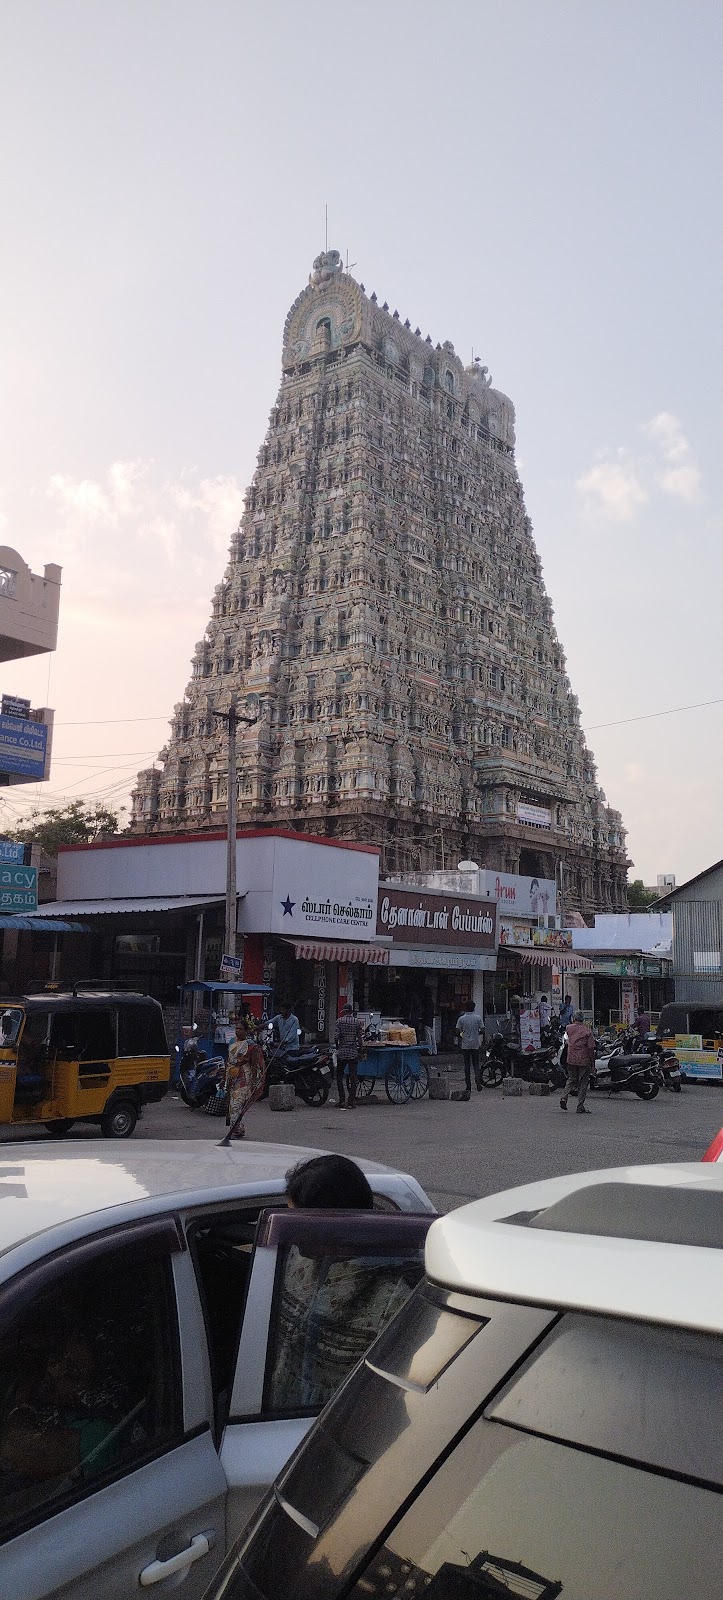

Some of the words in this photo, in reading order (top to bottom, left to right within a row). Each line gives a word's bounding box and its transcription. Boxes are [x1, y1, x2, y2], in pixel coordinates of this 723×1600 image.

[2, 871, 35, 888] acy
[494, 876, 516, 899] Arun
[305, 914, 336, 923] CELLPHONE
[350, 919, 368, 927] CENTRE
